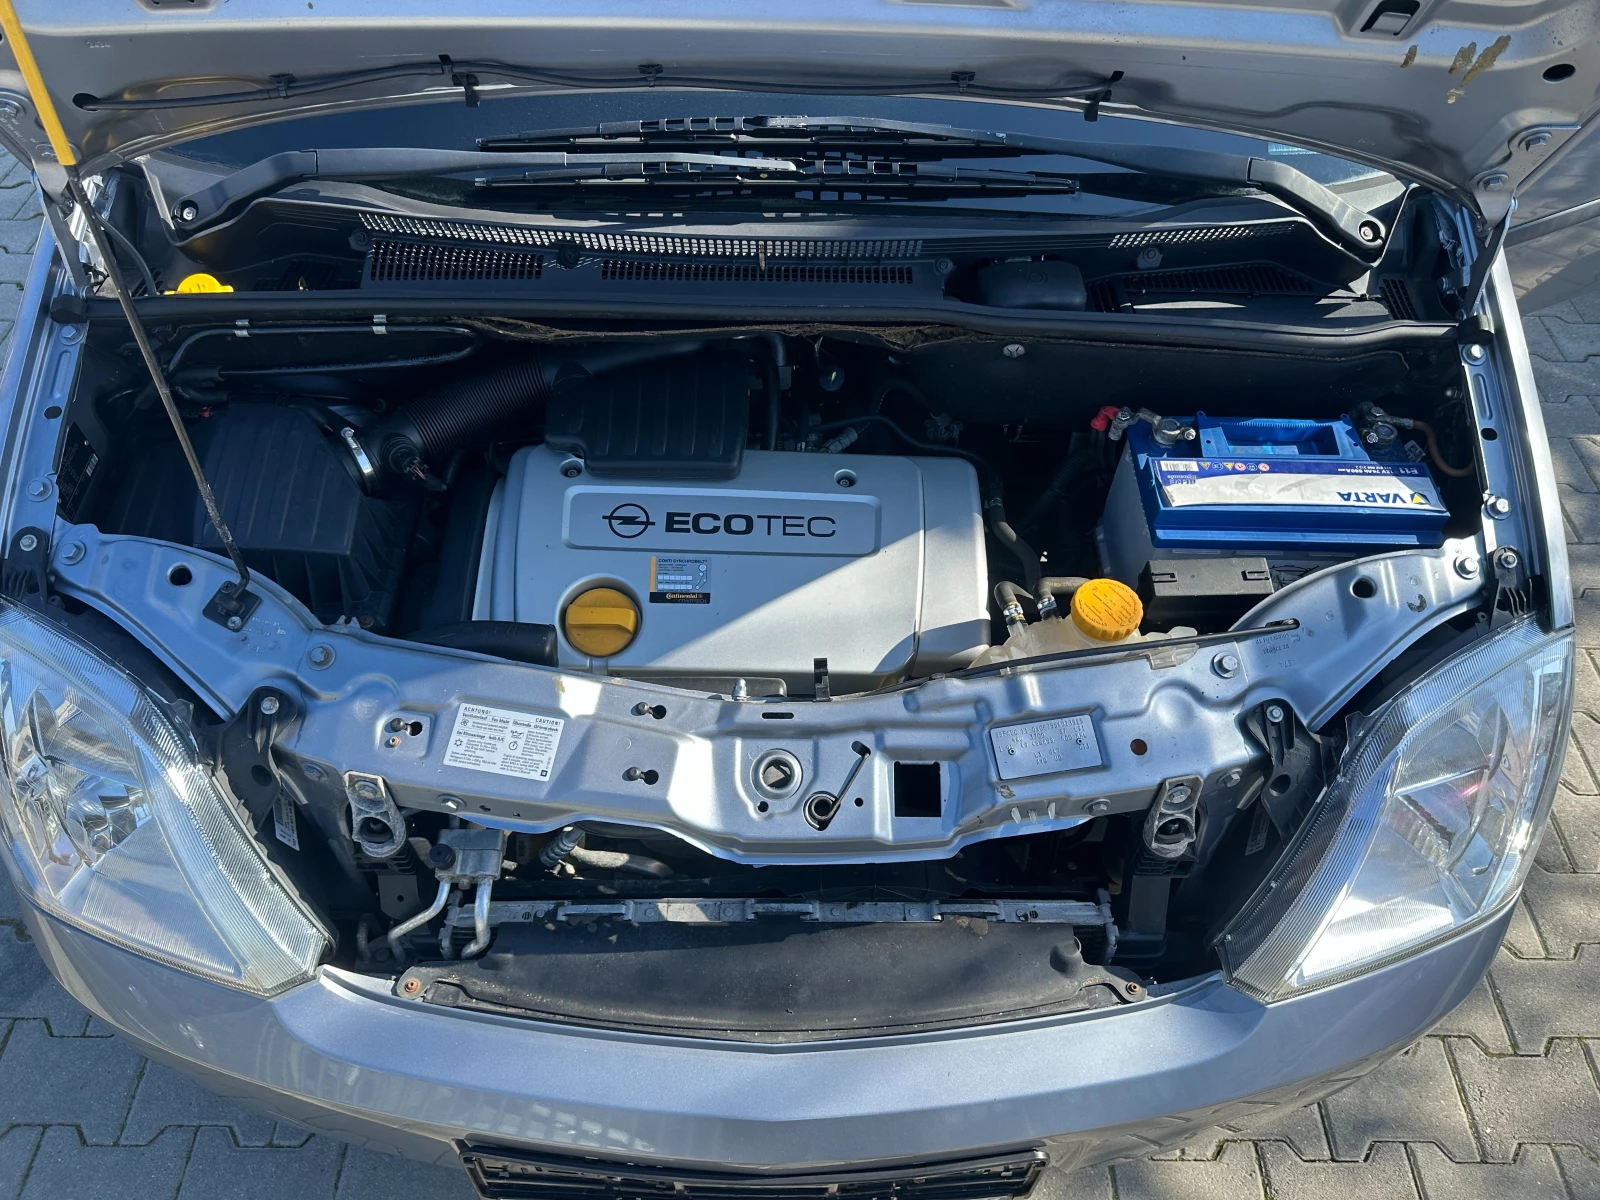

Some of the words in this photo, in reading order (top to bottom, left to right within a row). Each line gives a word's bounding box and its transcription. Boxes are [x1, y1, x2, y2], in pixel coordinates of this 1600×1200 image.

[1399, 467, 1418, 475] E11
[1336, 491, 1407, 504] VARTA
[664, 511, 837, 538] ECOTEC
[665, 592, 698, 600] Continental
[463, 706, 491, 714] ACHTUNG!
